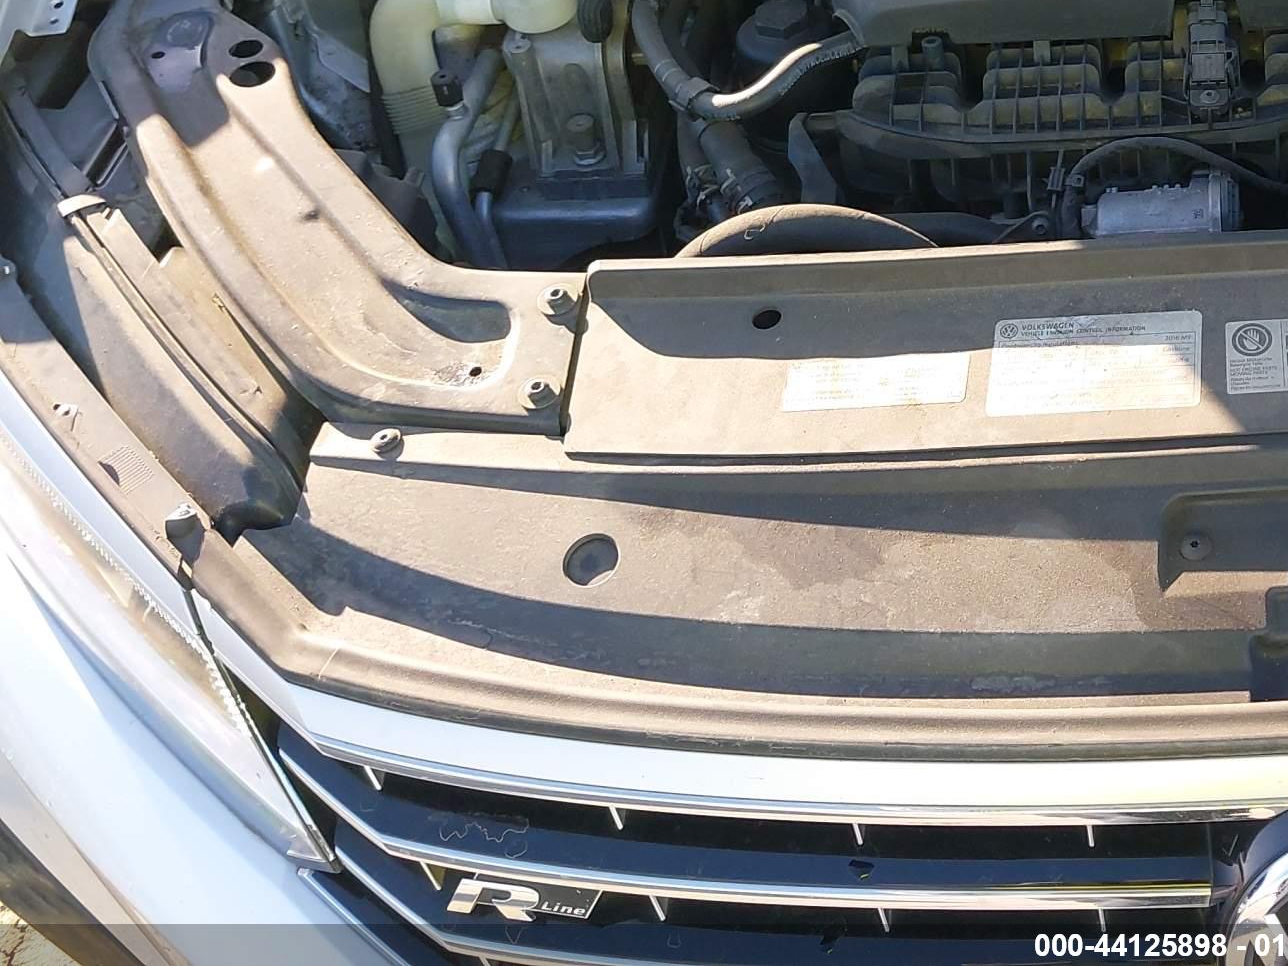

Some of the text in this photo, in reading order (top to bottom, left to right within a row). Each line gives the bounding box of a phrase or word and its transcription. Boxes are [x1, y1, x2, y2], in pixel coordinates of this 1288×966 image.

[1022, 321, 1075, 331] VOLKSWAGEN
[1105, 325, 1146, 333] INFORMATION
[446, 878, 586, 923] R Line
